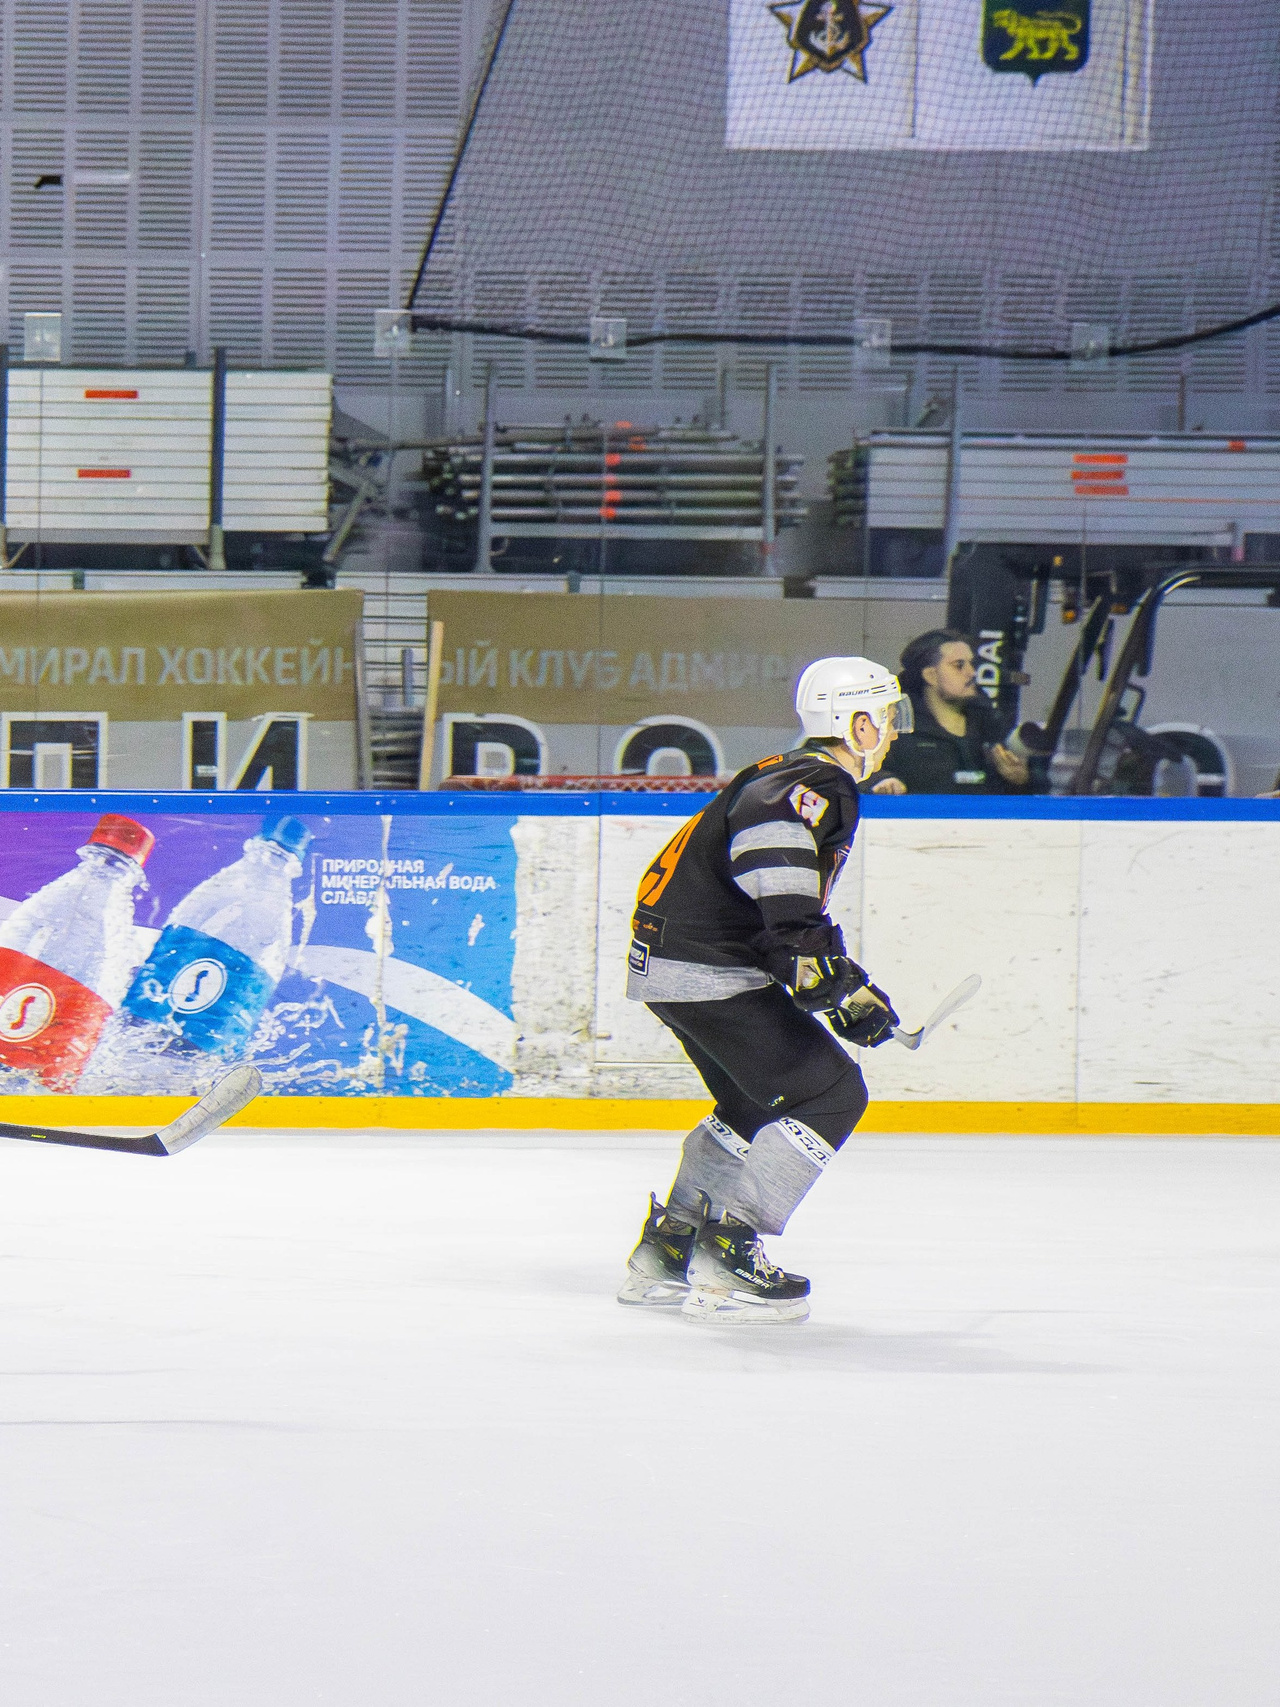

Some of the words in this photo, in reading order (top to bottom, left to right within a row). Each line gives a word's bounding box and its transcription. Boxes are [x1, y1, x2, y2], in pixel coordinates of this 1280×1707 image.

[509, 650, 621, 689] КЛУБ
[449, 875, 497, 893] ВОДА
[734, 1268, 770, 1288] BAUER
